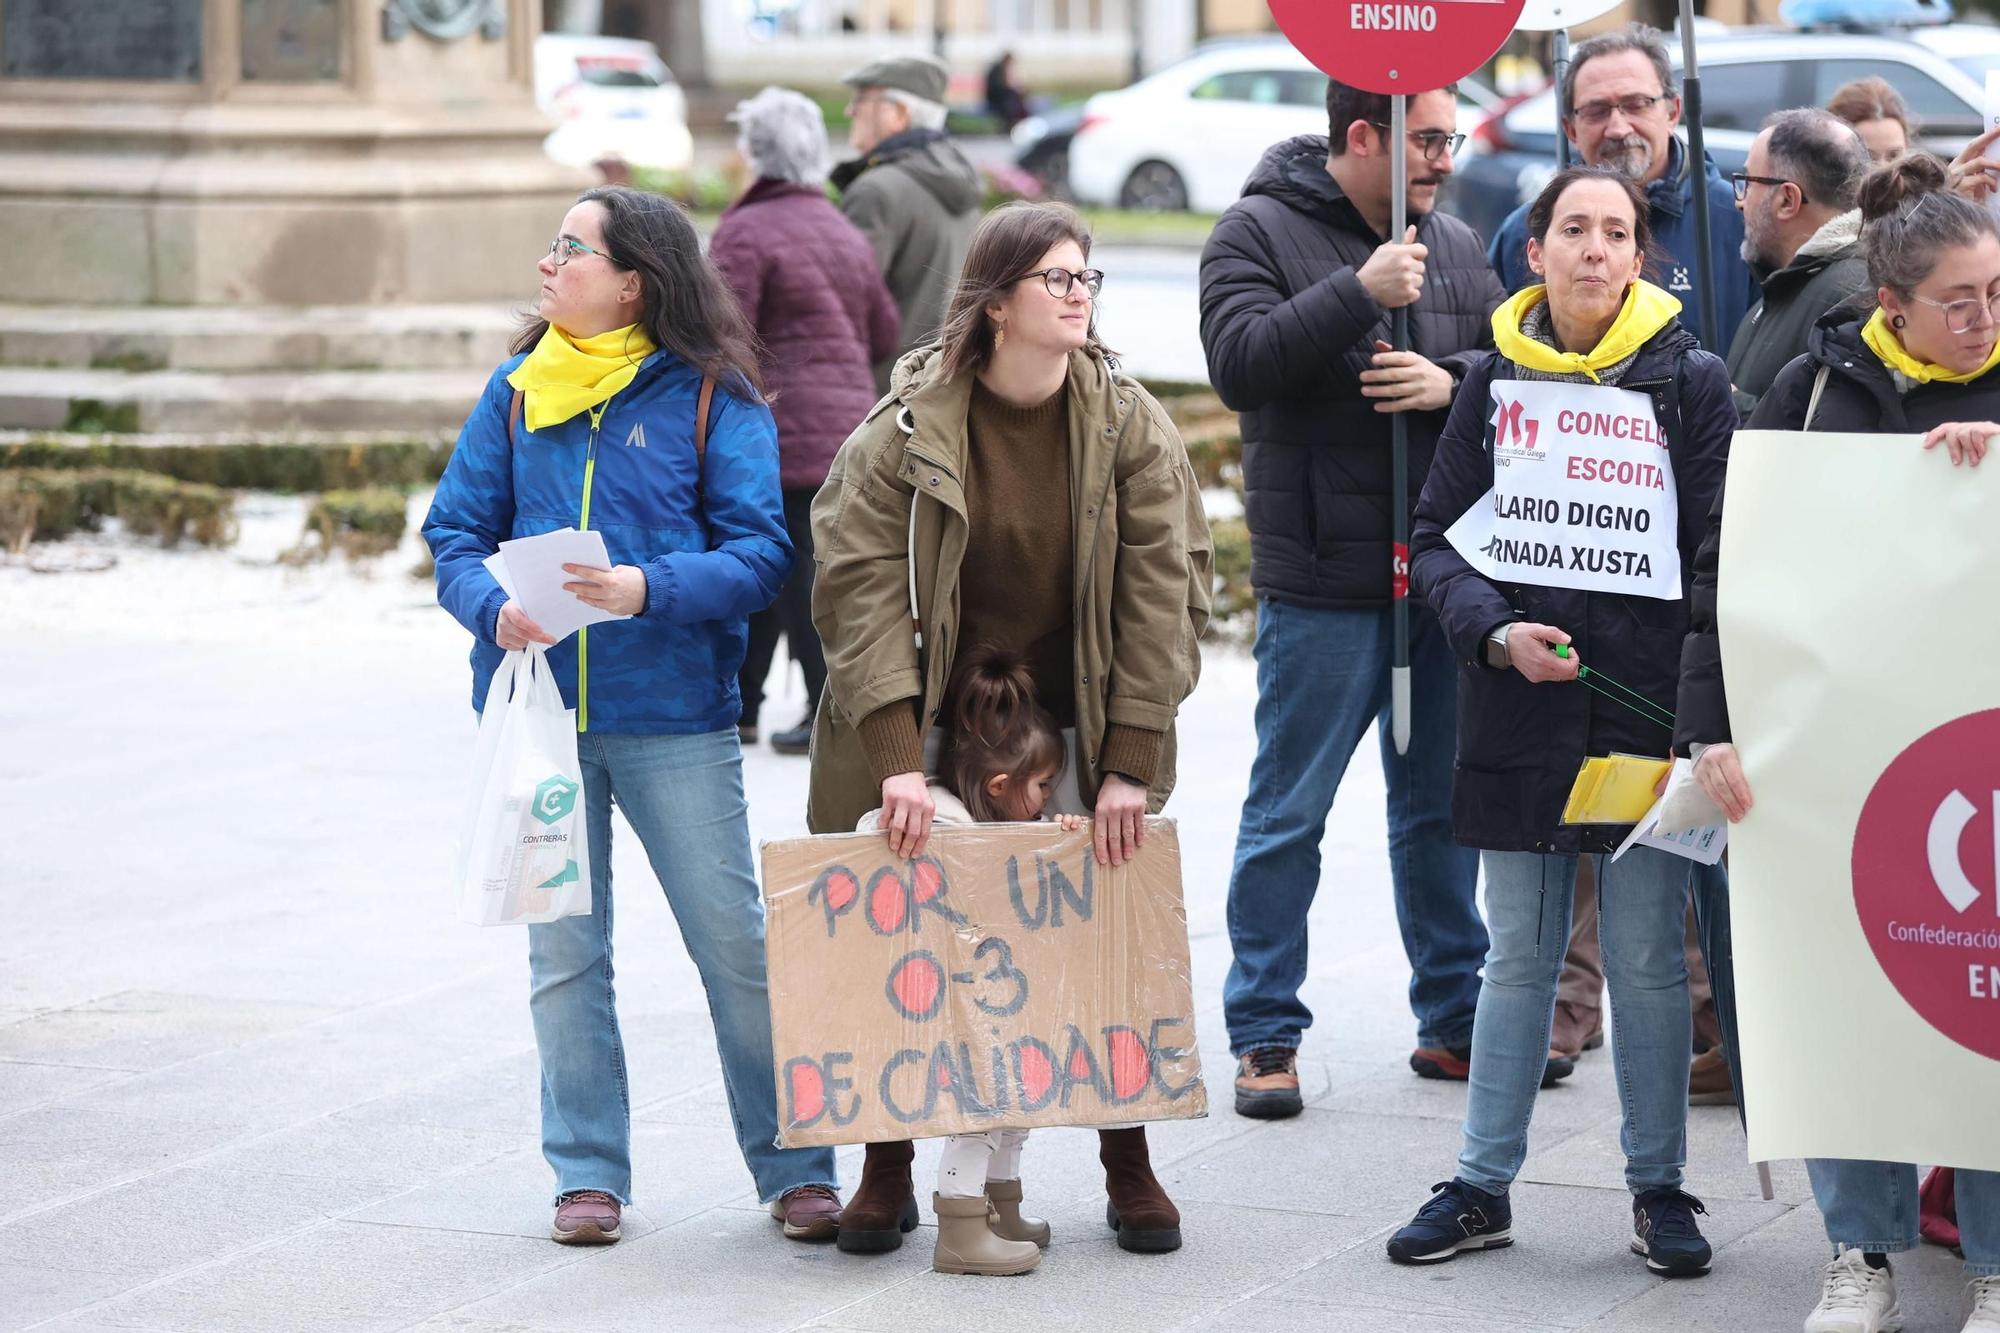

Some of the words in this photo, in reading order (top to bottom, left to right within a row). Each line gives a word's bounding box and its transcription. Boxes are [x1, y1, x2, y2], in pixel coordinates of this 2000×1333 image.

[1350, 3, 1437, 31] ENSINO
[1566, 456, 1665, 491] ESCOITA
[1567, 502, 1650, 533] DIGNO
[1569, 546, 1652, 578] XUSTA
[523, 834, 567, 843] CONTRERAS
[808, 854, 968, 937] POR
[1005, 847, 1094, 931] UN
[782, 1052, 862, 1128] DE
